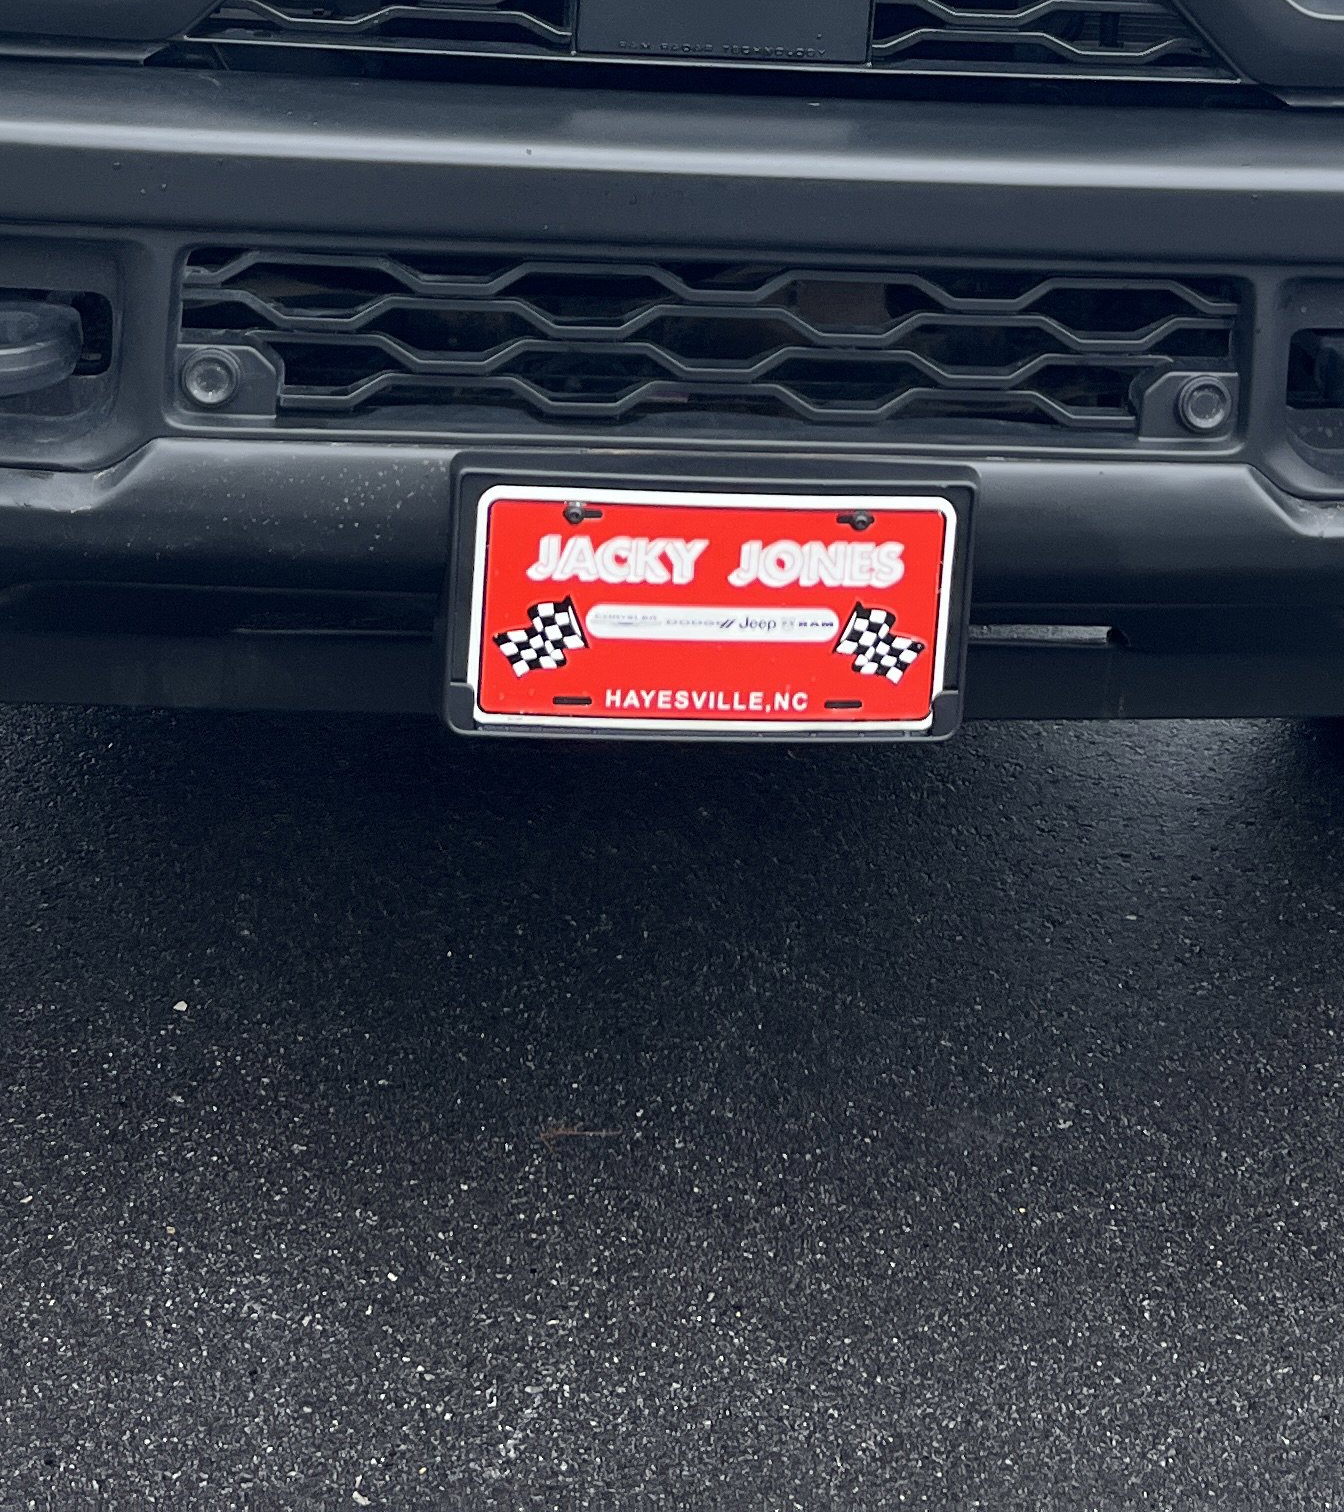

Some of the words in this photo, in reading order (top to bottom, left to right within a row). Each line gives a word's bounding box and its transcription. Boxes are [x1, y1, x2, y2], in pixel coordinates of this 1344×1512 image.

[526, 534, 710, 584] JACKY
[727, 540, 905, 588] JONES
[739, 615, 777, 631] Jeep
[605, 689, 809, 713] HAYESVILLE,NC
